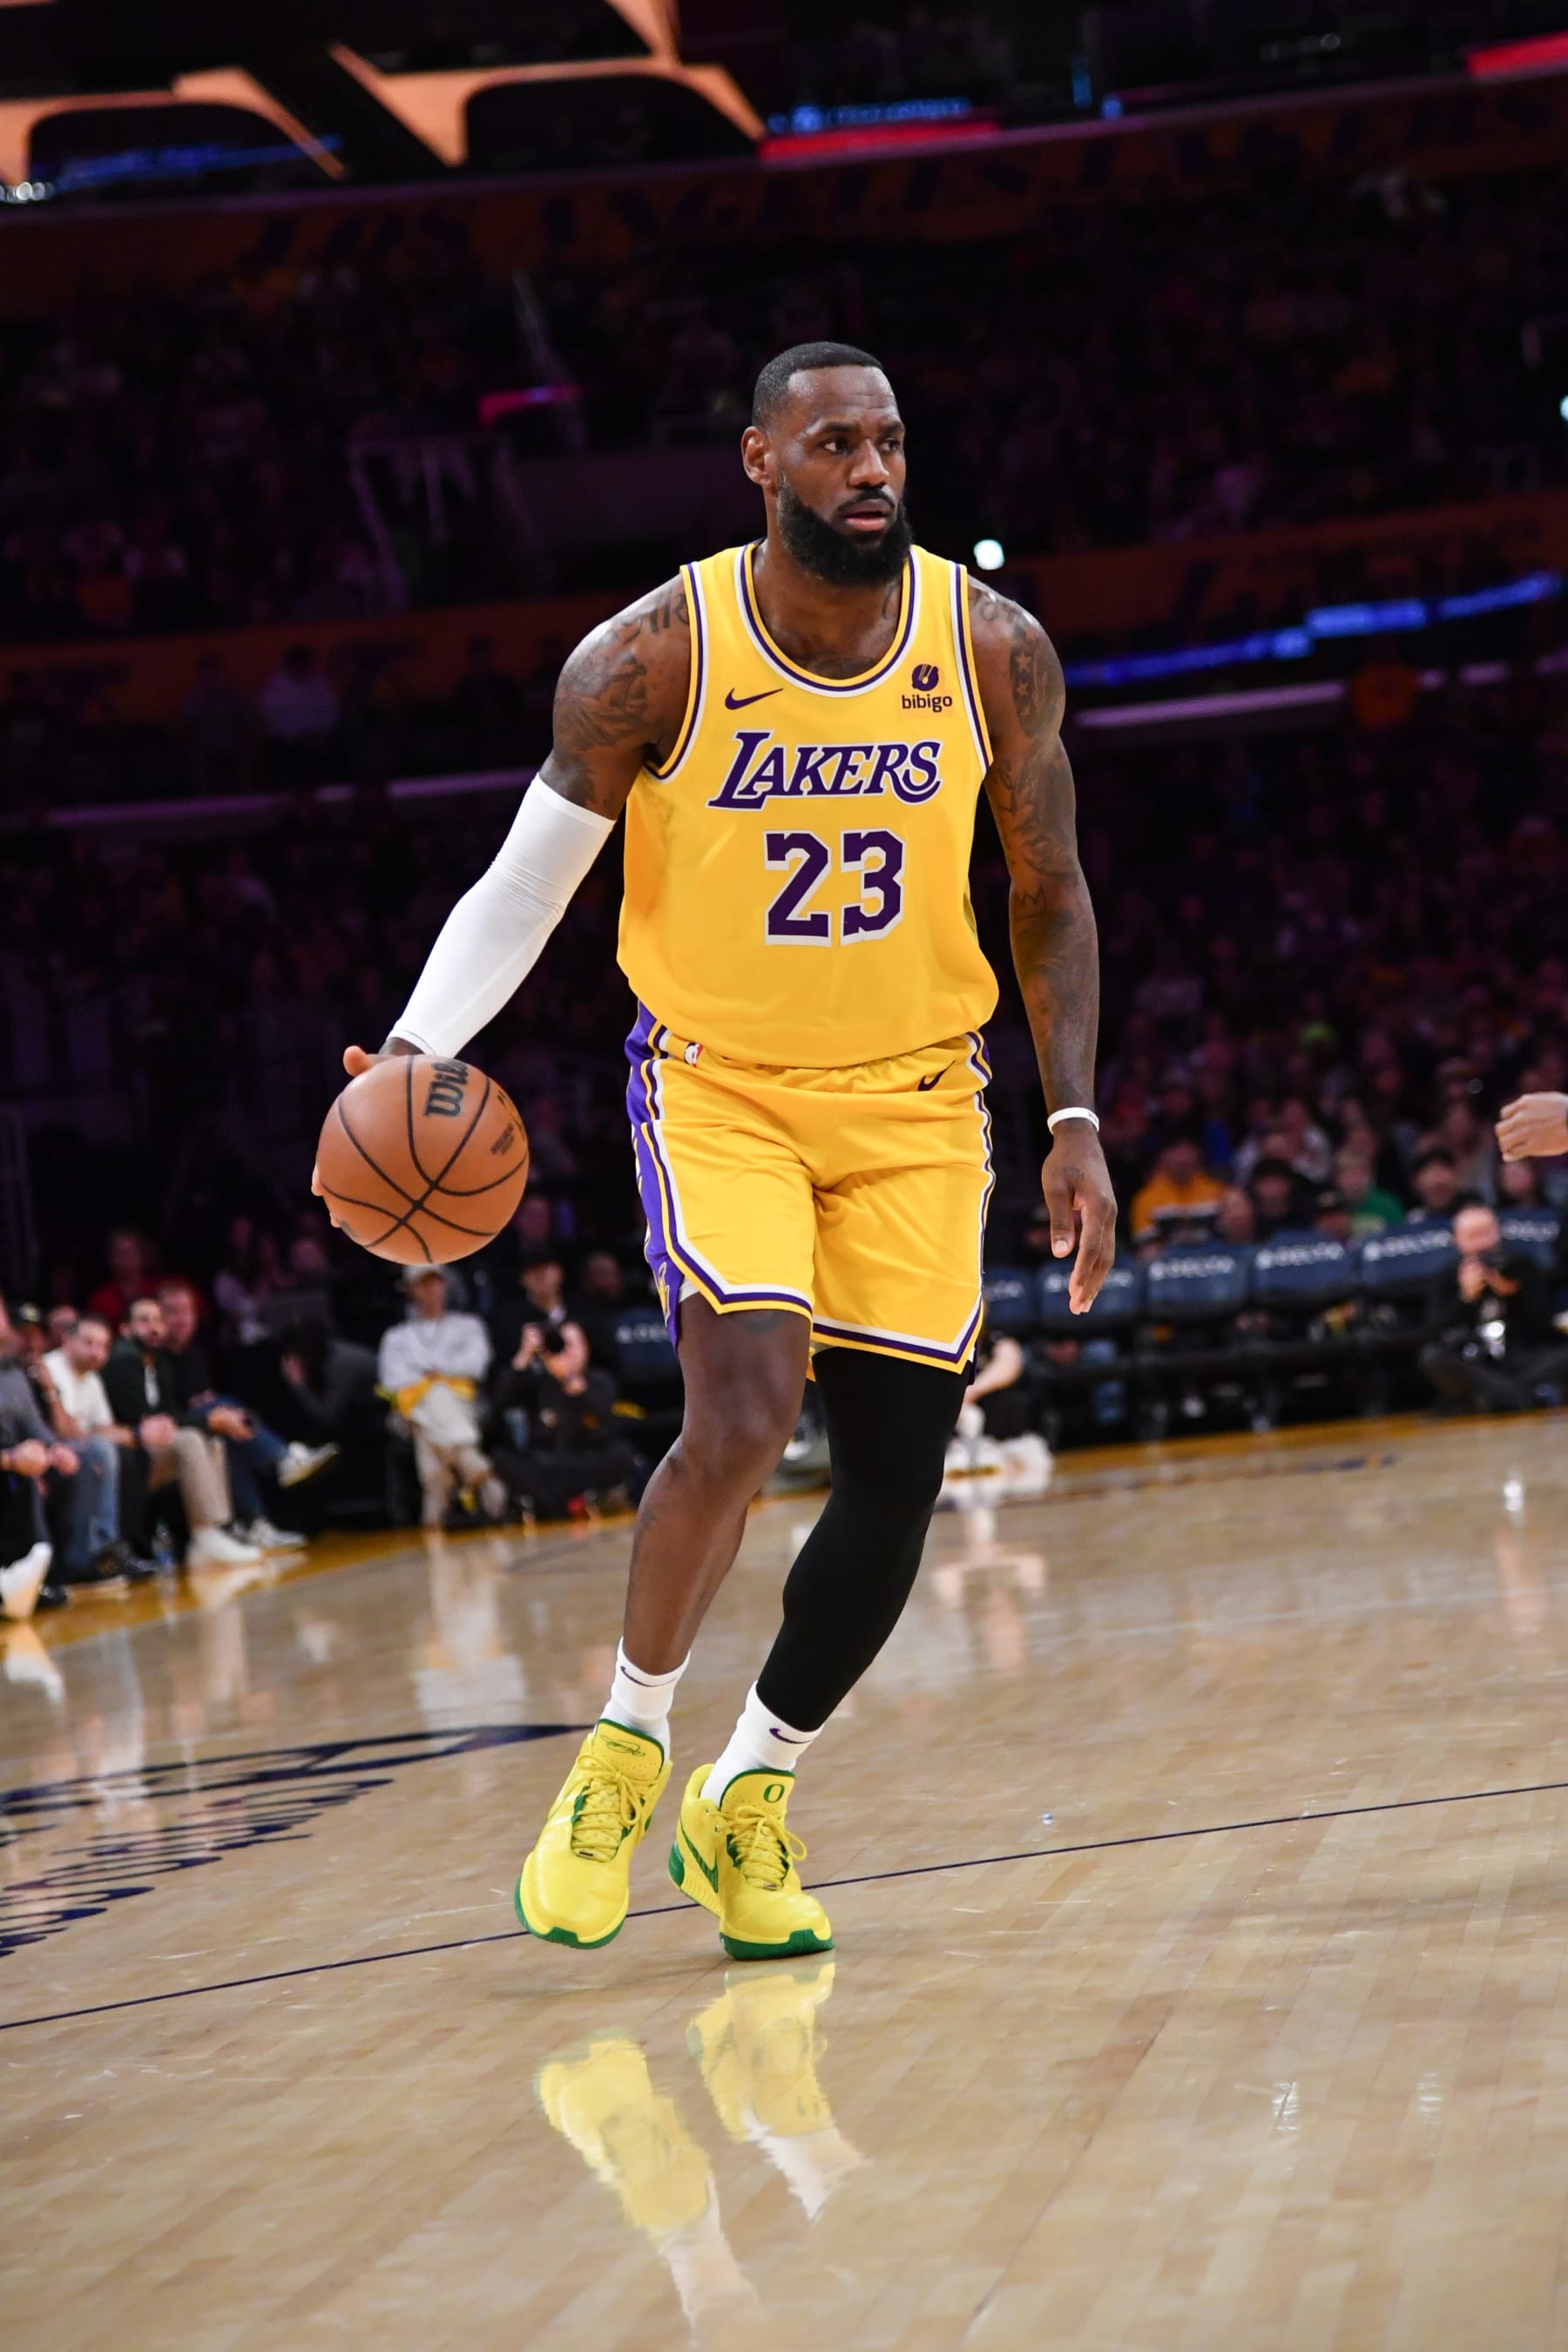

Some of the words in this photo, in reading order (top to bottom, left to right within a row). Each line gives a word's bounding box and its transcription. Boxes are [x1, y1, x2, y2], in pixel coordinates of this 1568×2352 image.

[902, 693, 953, 713] bibigo
[706, 729, 943, 812] LAKERS
[763, 828, 906, 948] 23
[422, 1058, 469, 1118] Wil
